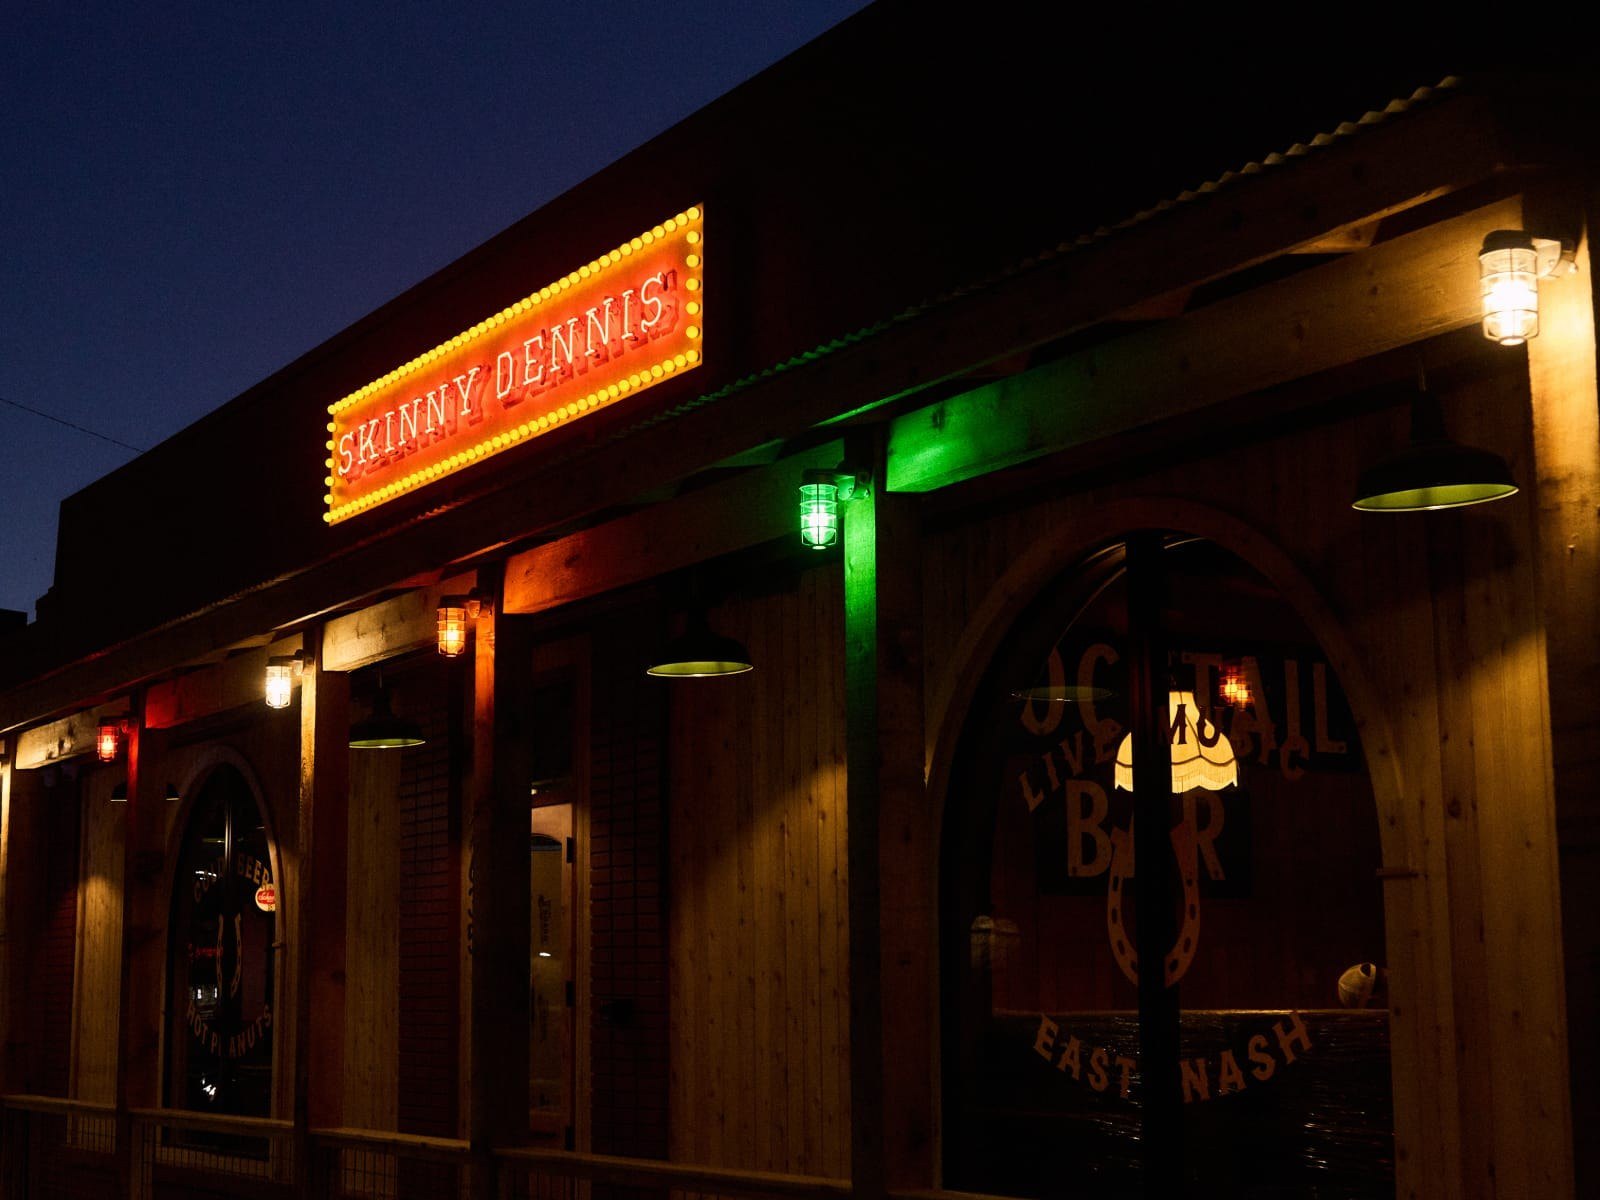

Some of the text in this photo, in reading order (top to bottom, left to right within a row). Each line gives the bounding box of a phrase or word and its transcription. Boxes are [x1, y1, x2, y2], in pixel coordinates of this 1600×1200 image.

[337, 271, 668, 478] SKINNY DENNIS
[1017, 717, 1121, 813] LIVE
[236, 852, 271, 889] BEER
[1064, 778, 1228, 881] BR
[186, 999, 273, 1058] HOT PANUTS
[1033, 1011, 1313, 1104] EAST NASH
